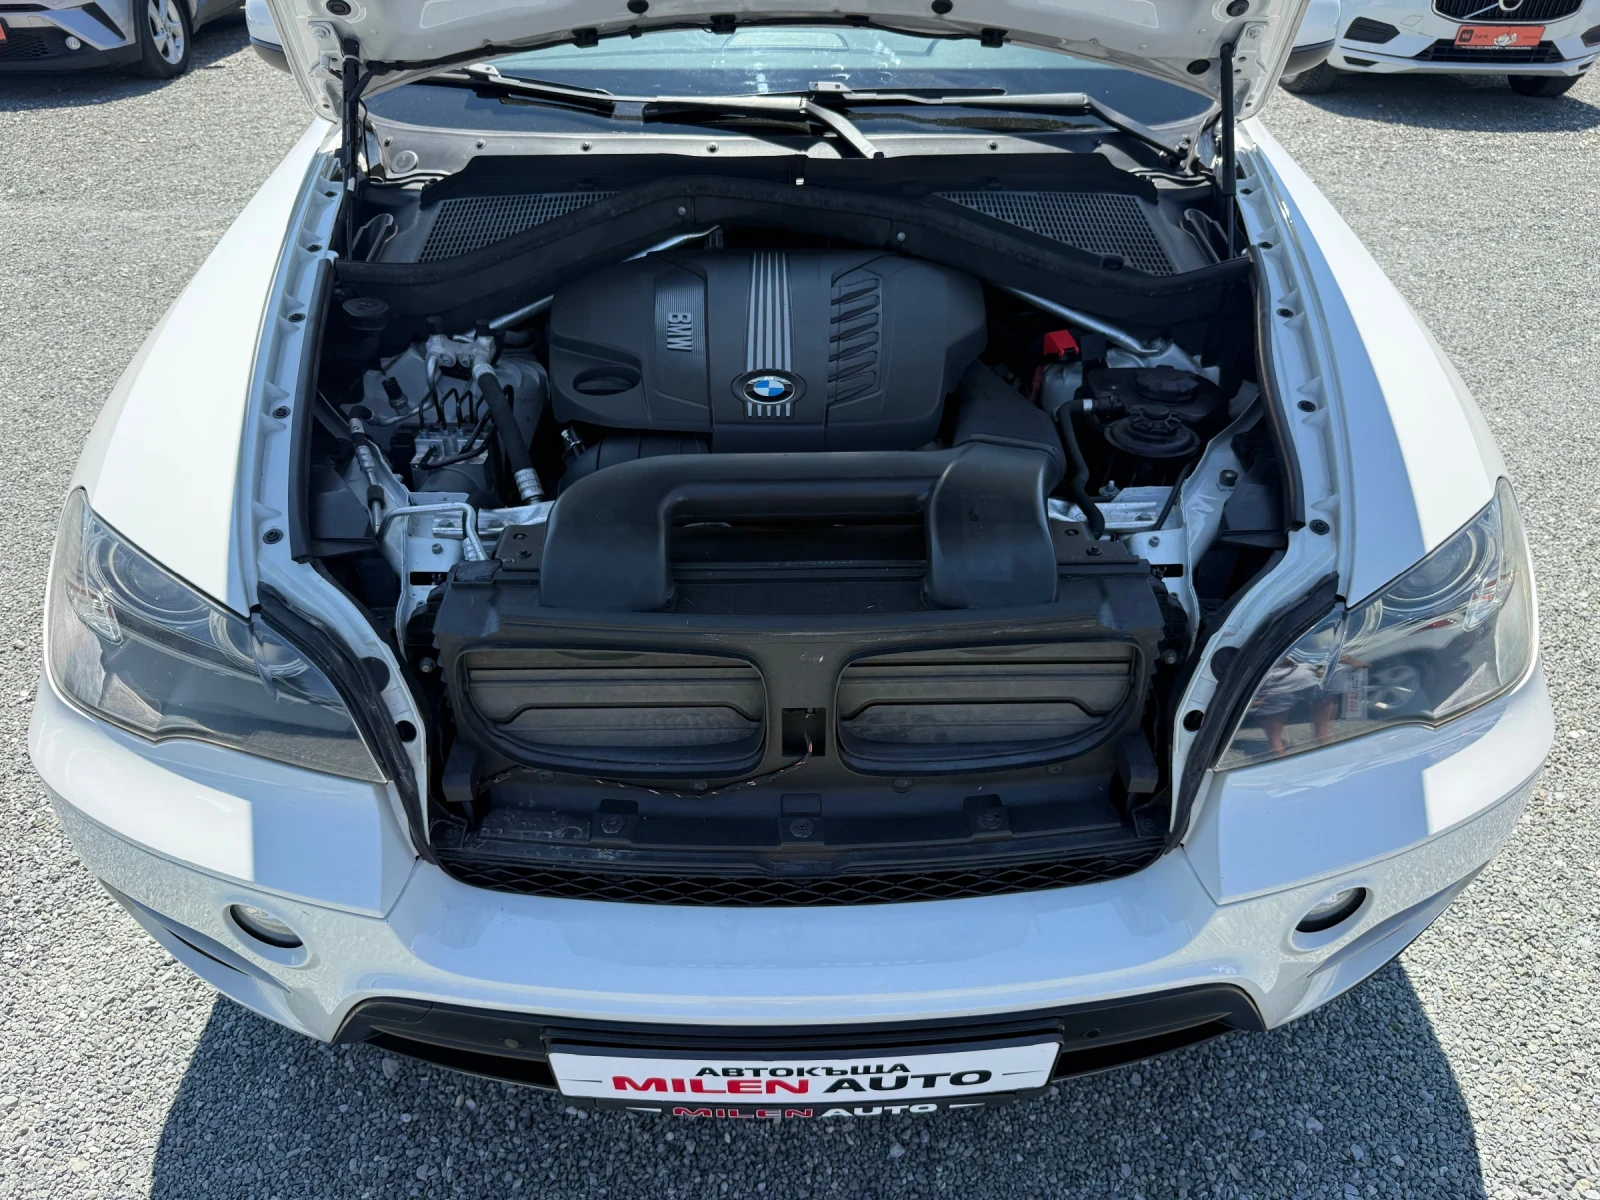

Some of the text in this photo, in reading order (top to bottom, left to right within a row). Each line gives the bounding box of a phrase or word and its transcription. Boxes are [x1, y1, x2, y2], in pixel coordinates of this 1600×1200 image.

[667, 312, 692, 351] BMW
[612, 1070, 992, 1094] MILEN AUTO
[672, 1103, 938, 1118] MILEN AUTO
